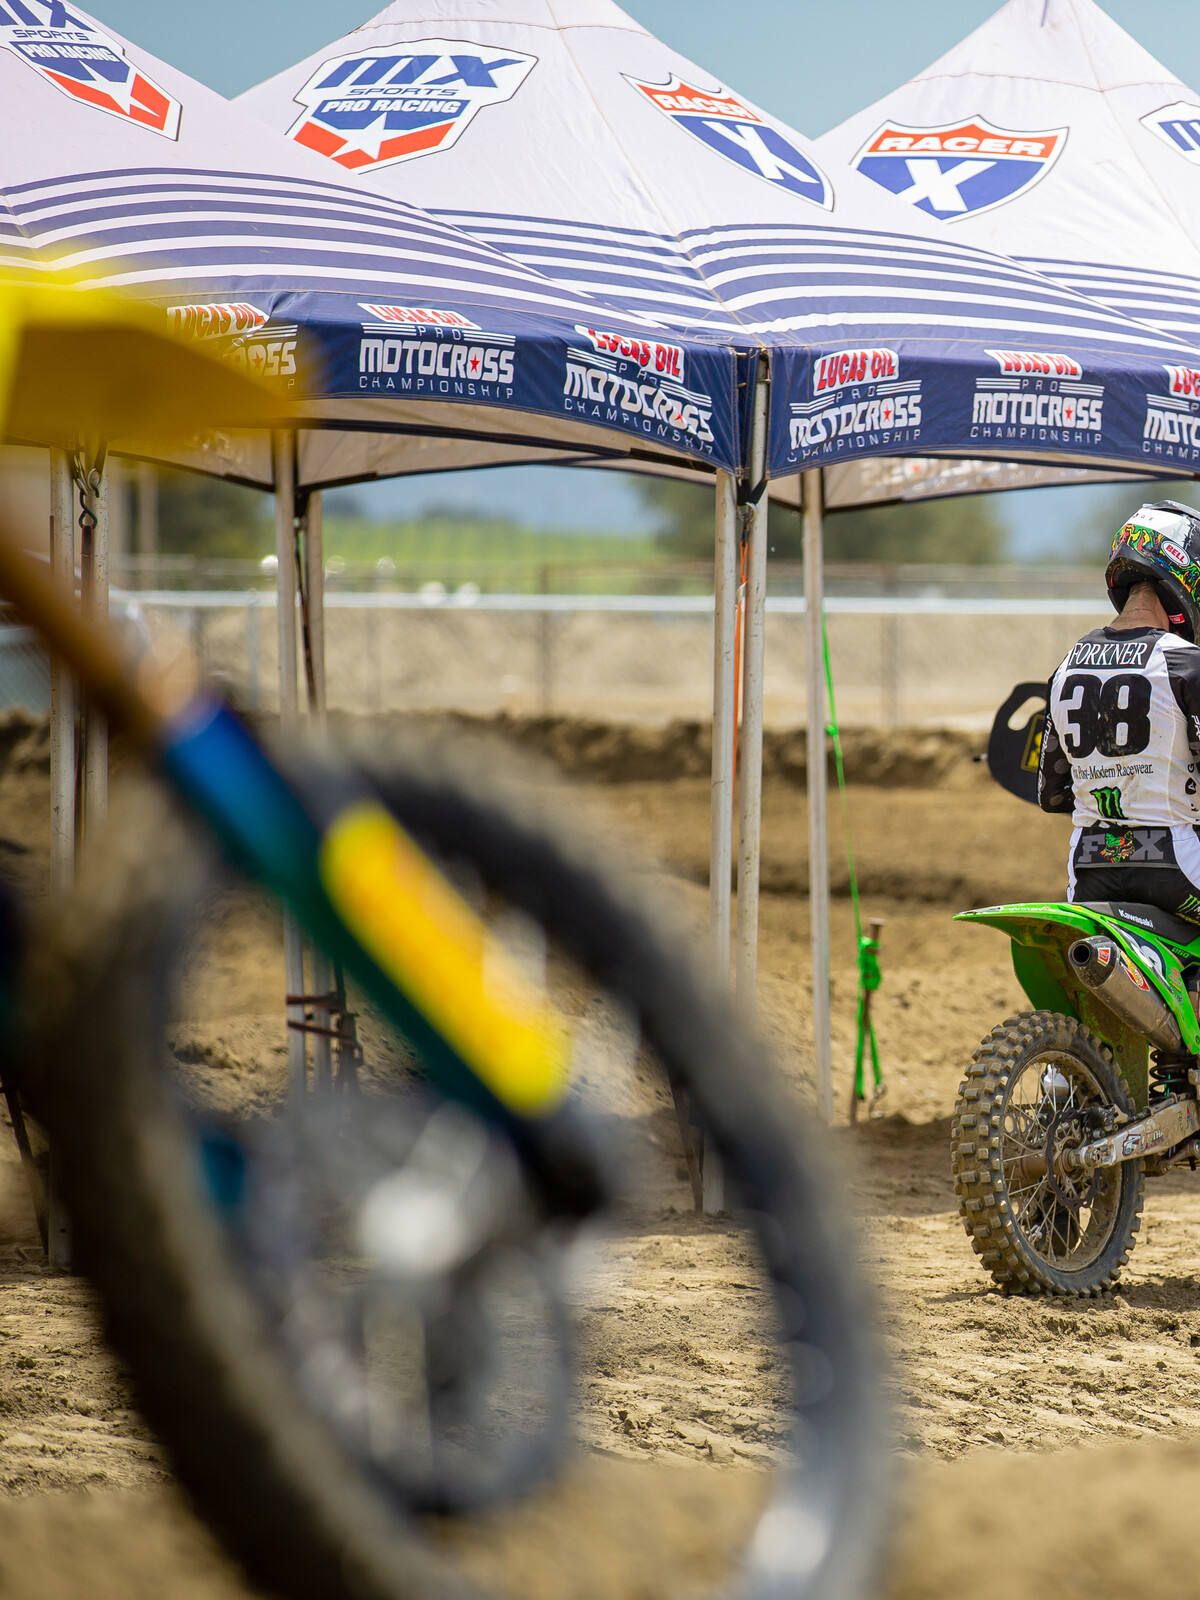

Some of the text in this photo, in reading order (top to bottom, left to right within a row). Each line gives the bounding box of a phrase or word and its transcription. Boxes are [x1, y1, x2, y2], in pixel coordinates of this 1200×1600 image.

[12, 29, 90, 41] SPORTS
[17, 43, 120, 62] PRO RACING
[313, 55, 526, 89] MX
[346, 87, 460, 97] SPORTS
[321, 100, 462, 114] PRO RACING
[652, 94, 756, 120] RACER
[701, 120, 820, 184] X
[877, 136, 1046, 156] RACER
[896, 158, 998, 212] X
[230, 304, 266, 330] OIL
[369, 305, 474, 327] LUCAS OIL
[417, 326, 463, 341] PRO
[359, 338, 516, 384] MOTOCROSS
[588, 328, 681, 377] LUCAS OIL
[995, 351, 1078, 375] LUCAS OIL
[817, 350, 896, 391] LUCAS OIL
[359, 376, 514, 399] CHAMPIONSHIP
[836, 385, 877, 403] PRO
[1022, 379, 1059, 393] PRO
[563, 362, 715, 443] MOTOCROSS
[972, 392, 1104, 431] MOTOCROSS
[789, 394, 922, 450] MOTOCROSS
[787, 429, 921, 463] CHAMPIONSHIP
[970, 426, 1102, 445] CHAMPIONSHIP
[1166, 544, 1185, 563] BELL
[1068, 642, 1148, 666] FORKNER
[1059, 673, 1152, 759] 38
[1118, 908, 1154, 929] Kawasaki
